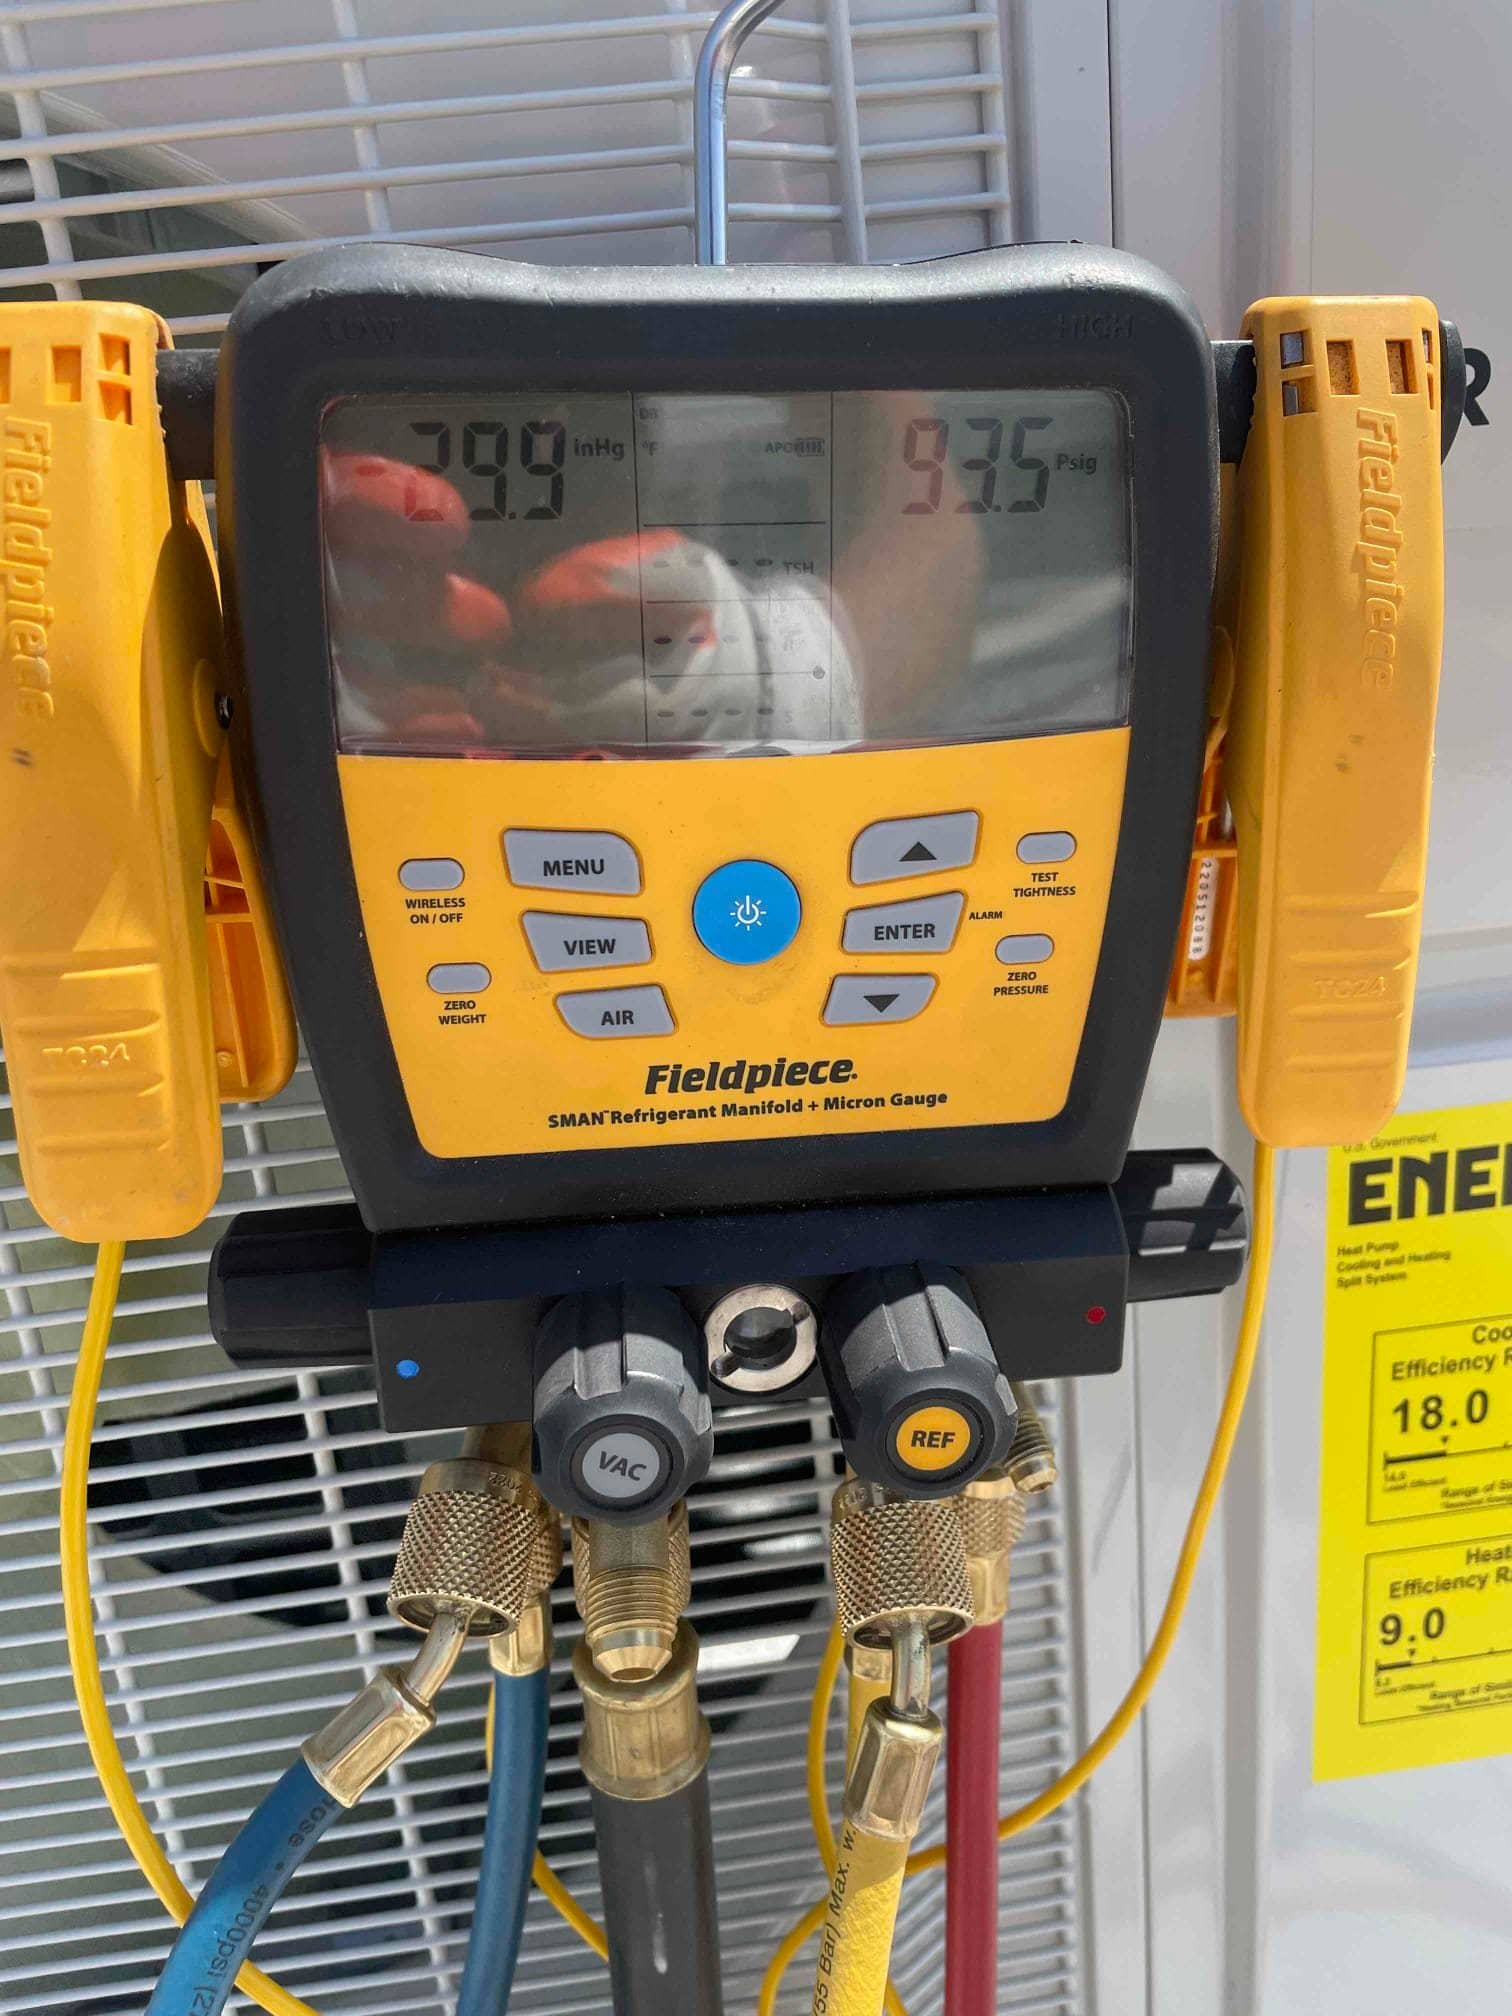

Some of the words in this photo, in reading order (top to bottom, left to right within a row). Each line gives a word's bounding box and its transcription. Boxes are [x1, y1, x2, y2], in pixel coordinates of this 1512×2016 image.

[574, 438, 625, 461] inHg
[901, 417, 1054, 514] 93.5
[1056, 453, 1097, 476] Psig
[1352, 406, 1405, 690] Fieldpiece
[542, 858, 605, 877] MENU
[1031, 872, 1058, 883] TEST
[1013, 886, 1076, 898] TIGHTNESS
[405, 897, 466, 909] WIRELESS
[410, 914, 431, 924] ON
[439, 913, 463, 924] OFF
[969, 910, 1003, 920] ALARM
[873, 923, 936, 941] ENTER
[563, 938, 617, 955] VIEW
[1007, 971, 1037, 982] ZERO
[993, 984, 1049, 996] PRESSURE
[444, 1000, 476, 1011] ZERO
[438, 1013, 487, 1025] WEIGHT
[601, 1010, 634, 1026] AIR
[610, 1106, 717, 1124] Refrigerant
[721, 1099, 803, 1117] Manifold
[807, 1101, 819, 1112] +
[823, 1094, 886, 1111] Micron
[890, 1092, 948, 1109] Gauge
[1370, 1131, 1437, 1150] Government
[1348, 1143, 1512, 1226] ENE
[1336, 1244, 1363, 1256] Heat
[1366, 1241, 1399, 1252] Pump
[1336, 1259, 1381, 1273] Cooling
[1384, 1255, 1405, 1266] and
[1408, 1250, 1451, 1263] Heating
[1336, 1277, 1362, 1289] Split
[1366, 1271, 1407, 1286] System
[1391, 1354, 1496, 1381] Efficiency
[1392, 1389, 1489, 1434] 18.0
[910, 1430, 956, 1449] REF
[598, 1450, 648, 1482] VAC
[1388, 1573, 1489, 1599] Efficiency
[1379, 1607, 1445, 1645] 9.0
[828, 1862, 850, 1917] Max.
[819, 1922, 841, 1977] Bar)
